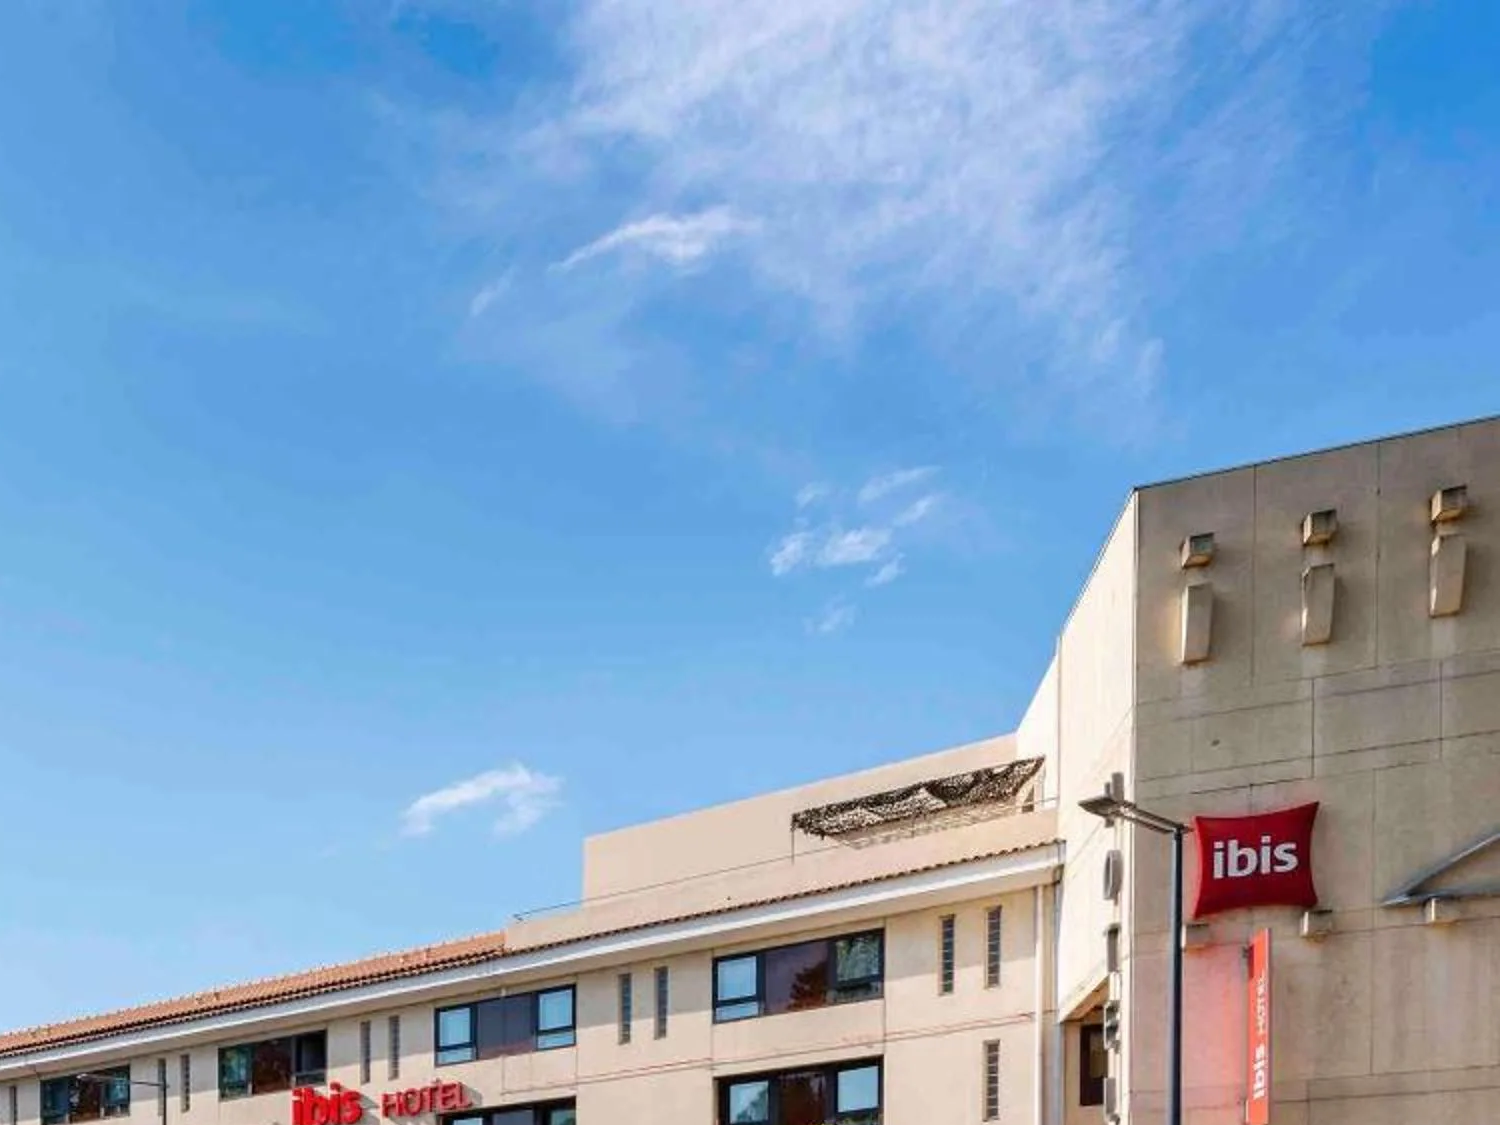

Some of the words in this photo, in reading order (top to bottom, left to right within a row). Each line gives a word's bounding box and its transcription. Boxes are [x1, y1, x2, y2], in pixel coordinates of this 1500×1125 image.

[1212, 834, 1299, 879] ibis
[1252, 1043, 1266, 1099] ibis
[381, 1081, 473, 1117] HOTEL
